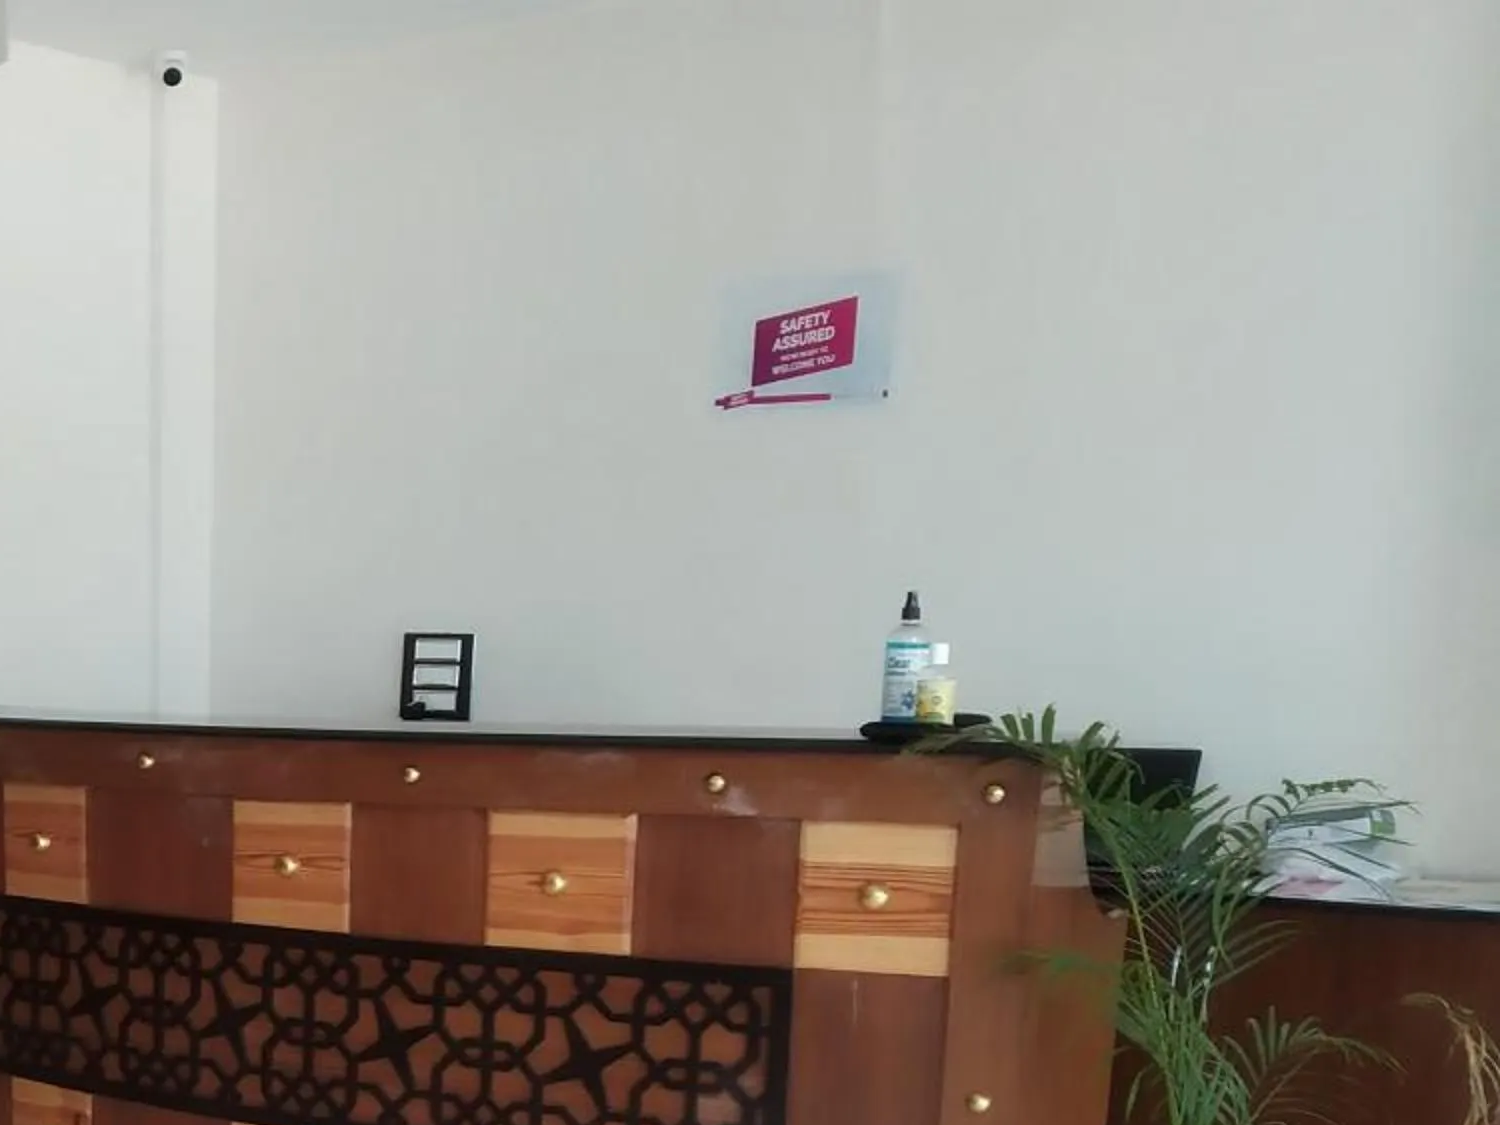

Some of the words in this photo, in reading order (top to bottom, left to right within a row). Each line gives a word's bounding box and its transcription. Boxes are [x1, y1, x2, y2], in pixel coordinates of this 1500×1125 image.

[780, 309, 832, 334] SAFETY
[772, 326, 836, 352] ASSURED
[816, 353, 836, 366] YOU
